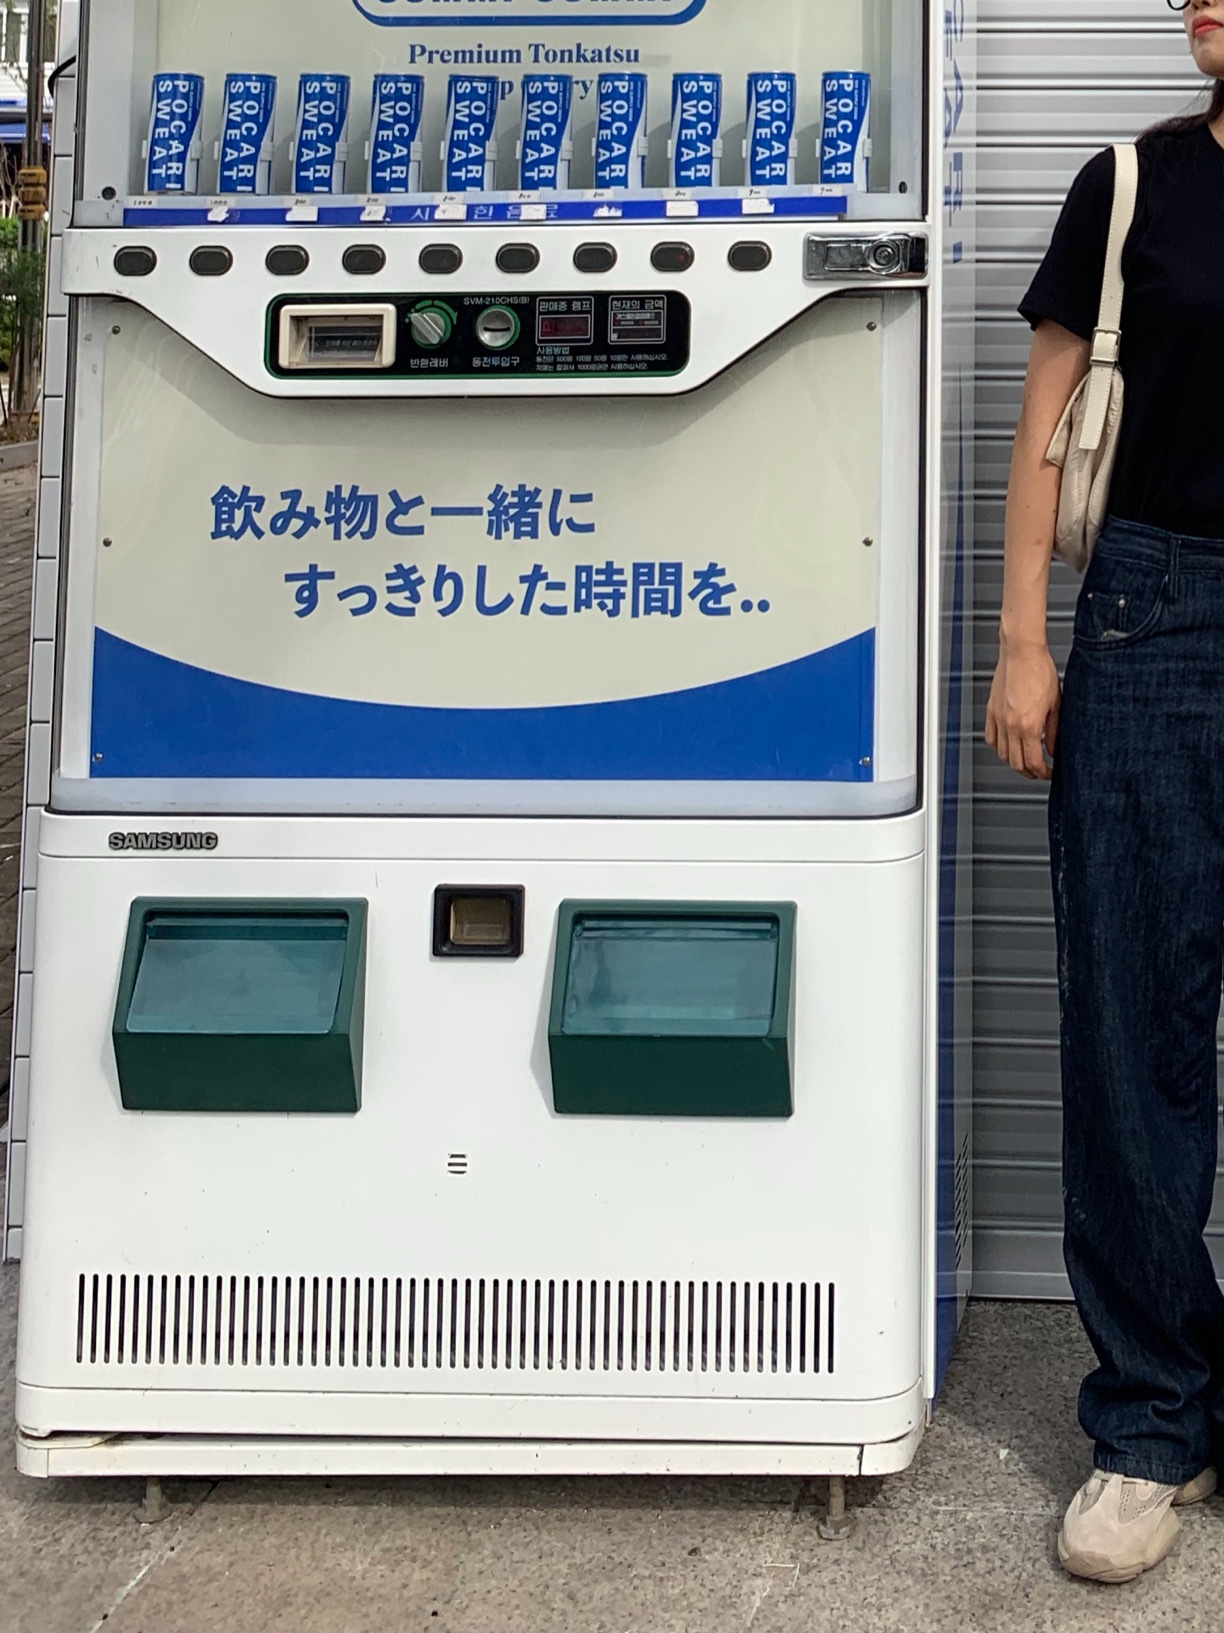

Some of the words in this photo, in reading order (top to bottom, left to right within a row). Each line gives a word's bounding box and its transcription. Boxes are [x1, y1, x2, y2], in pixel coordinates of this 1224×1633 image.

[409, 43, 522, 64] Premium
[528, 42, 640, 64] Tonkatsu
[152, 80, 172, 177] SWEAT
[166, 80, 189, 189] POCARI
[224, 81, 244, 180] SWEAT
[237, 81, 260, 191] POCARI
[300, 81, 320, 180] SWEAT
[313, 81, 336, 192] POCARI
[376, 81, 395, 181] SWEAT
[390, 82, 412, 192] POCARI
[452, 81, 471, 181] SWEAT
[466, 82, 487, 191] POCARI
[525, 81, 542, 181] SWEAT
[598, 81, 612, 180] SWEAT
[680, 80, 697, 180] SWEAT
[695, 81, 713, 187] POCAR
[755, 80, 772, 178] SWEAT
[771, 80, 787, 186] POCAR
[823, 80, 837, 178] SWEAT
[410, 206, 494, 220] 시한
[463, 296, 530, 305] SVM-210CHS(B)
[612, 299, 640, 310] 현재의
[644, 299, 664, 310] 금액
[410, 358, 449, 369] 반환레버
[472, 356, 520, 368] 동전투입구
[210, 484, 596, 540] 飲み物と一緒に
[108, 831, 219, 850] SAMSUNG
